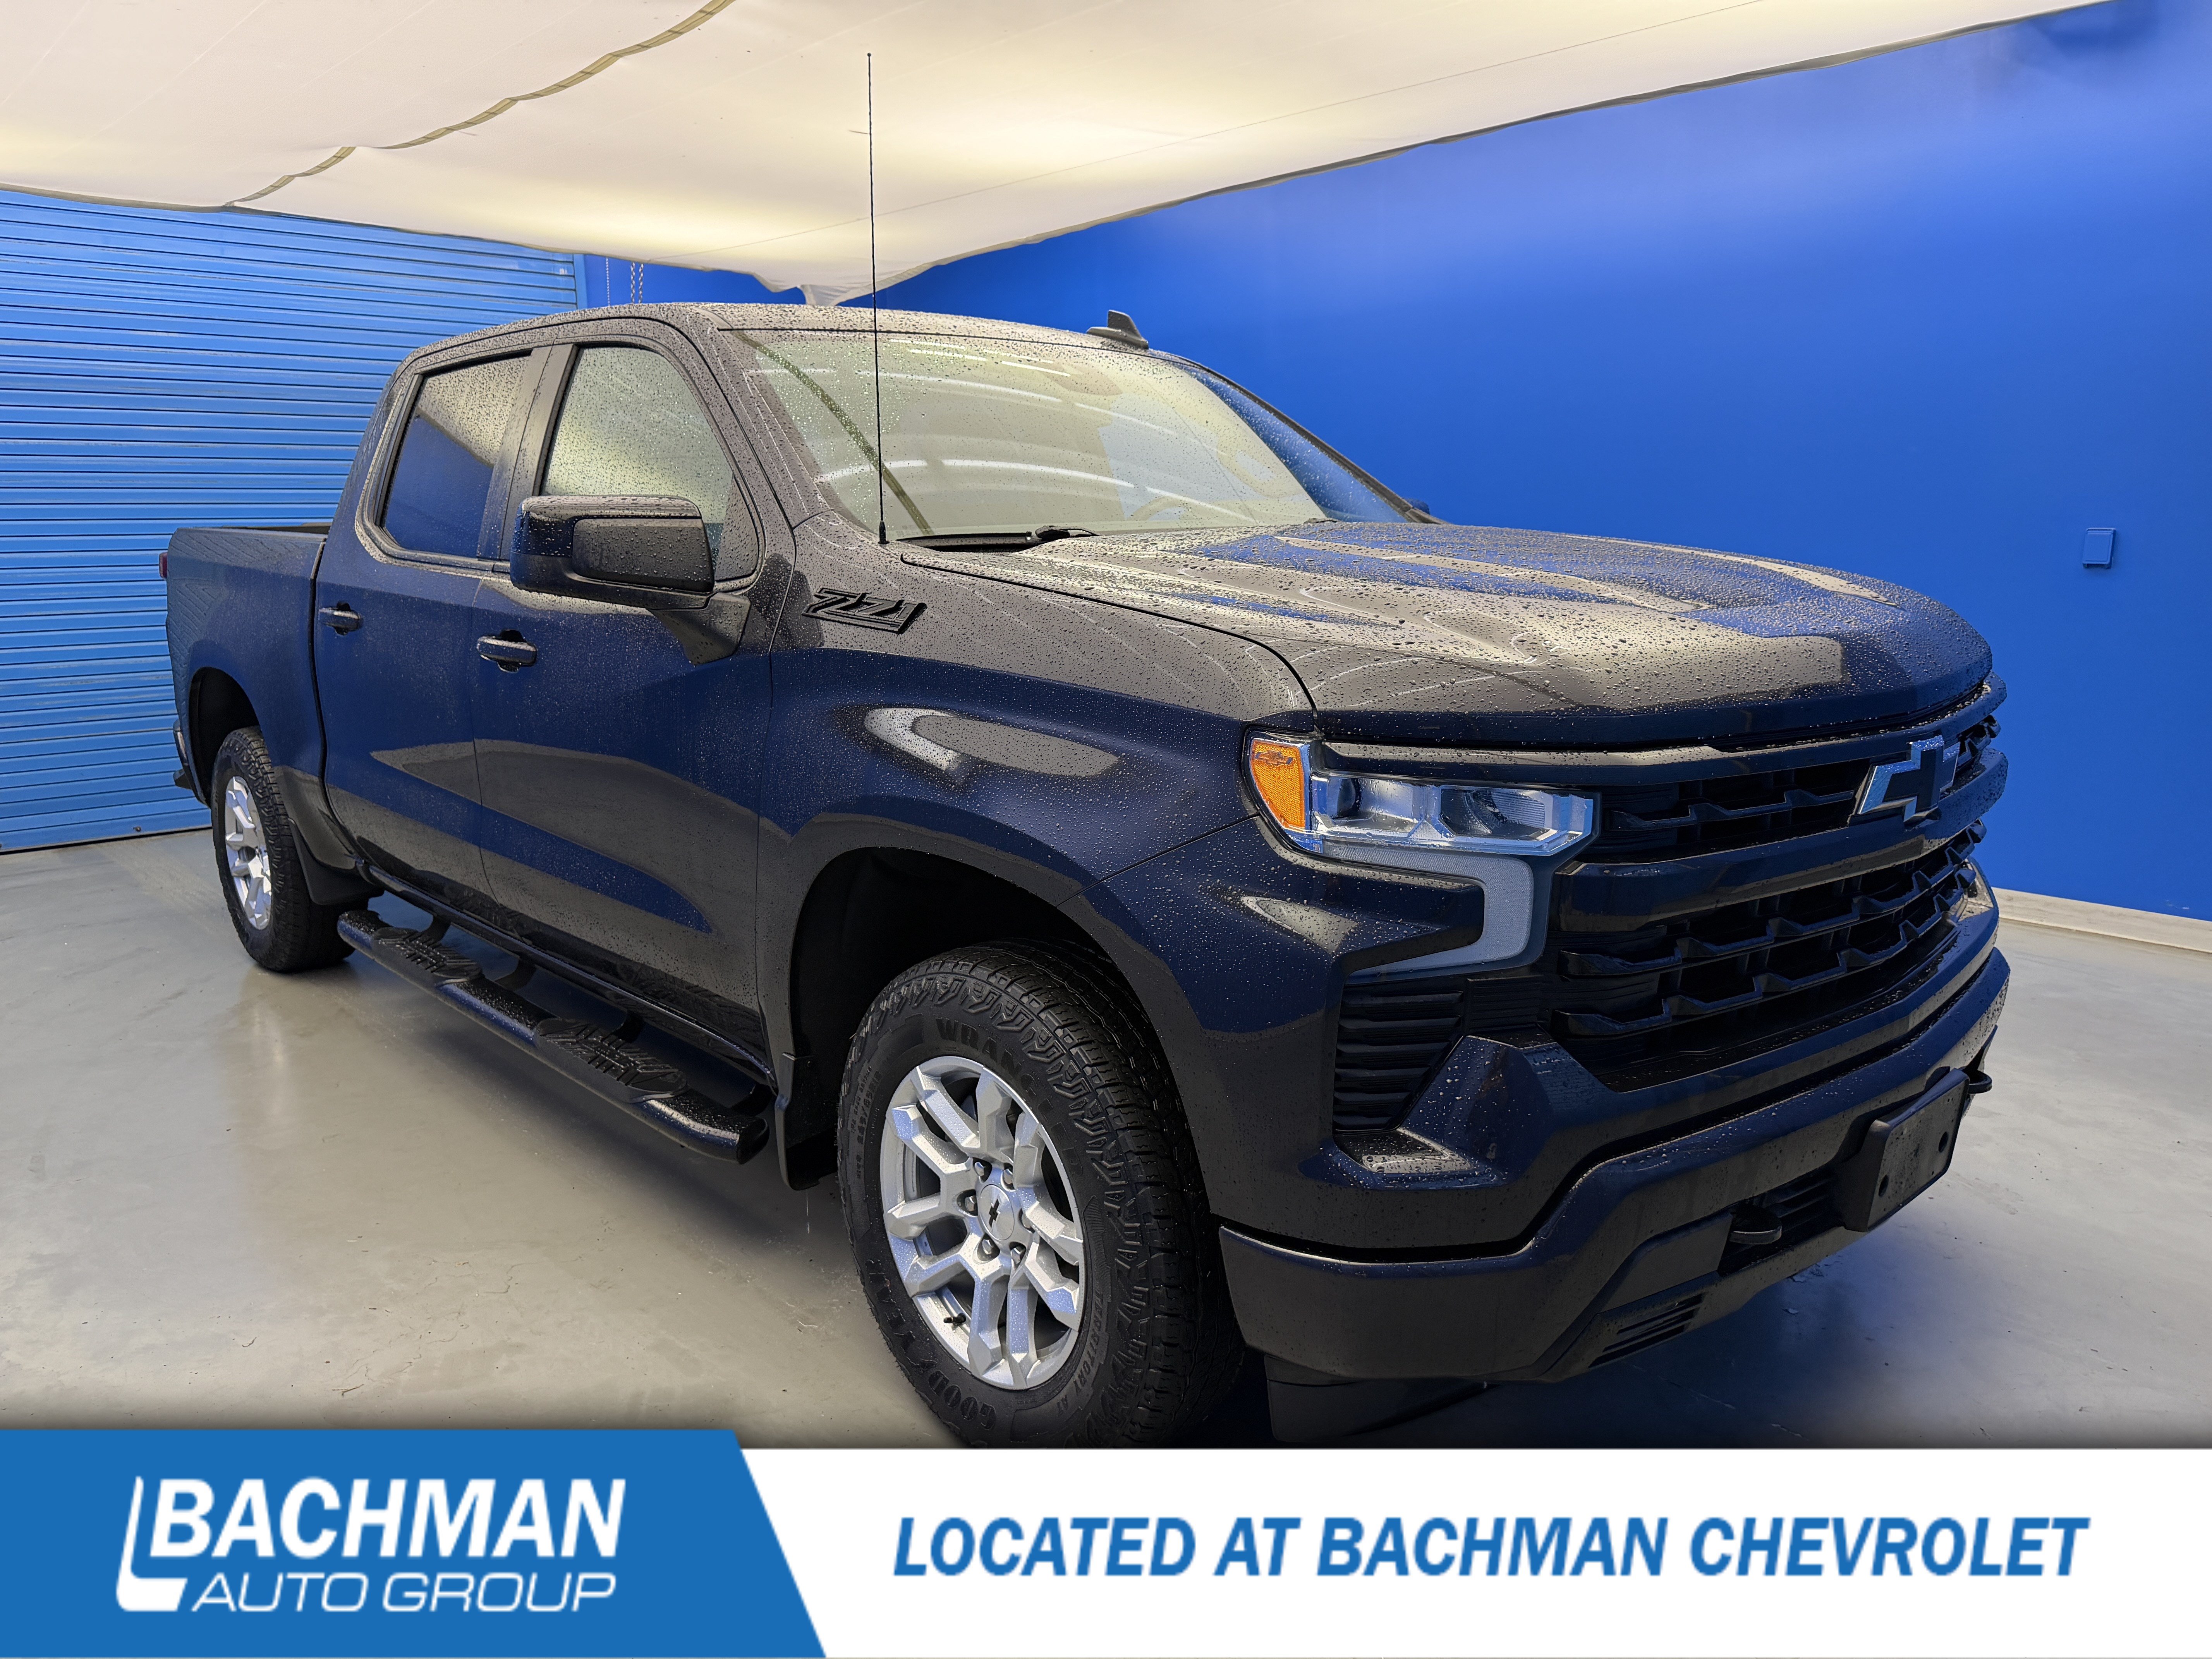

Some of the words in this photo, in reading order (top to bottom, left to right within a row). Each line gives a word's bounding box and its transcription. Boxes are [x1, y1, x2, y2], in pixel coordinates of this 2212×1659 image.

[801, 585, 927, 634] Z71
[935, 1017, 1084, 1176] WRANGLER
[864, 1259, 997, 1431] GOODYEAR
[1073, 1290, 1104, 1393] TERRITORY
